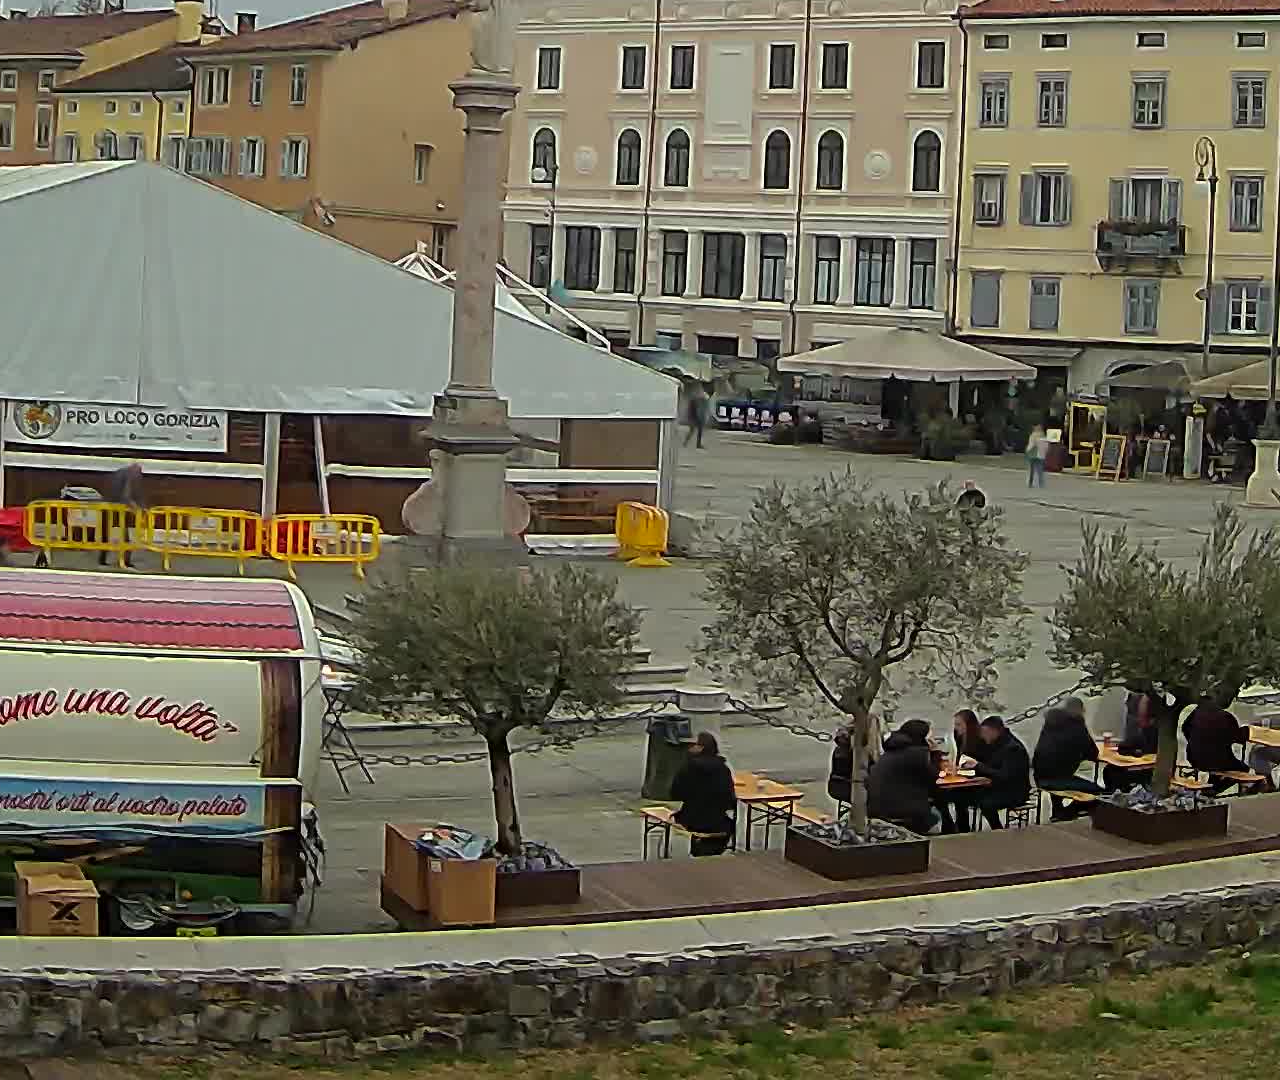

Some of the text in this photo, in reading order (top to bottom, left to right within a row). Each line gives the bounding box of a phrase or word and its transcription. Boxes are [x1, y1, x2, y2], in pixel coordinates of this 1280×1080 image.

[66, 410, 221, 428] PRO LOCO GORIZIA
[63, 689, 131, 716] una
[93, 791, 119, 813] al
[117, 795, 179, 815] vostro
[176, 793, 248, 822] palato
